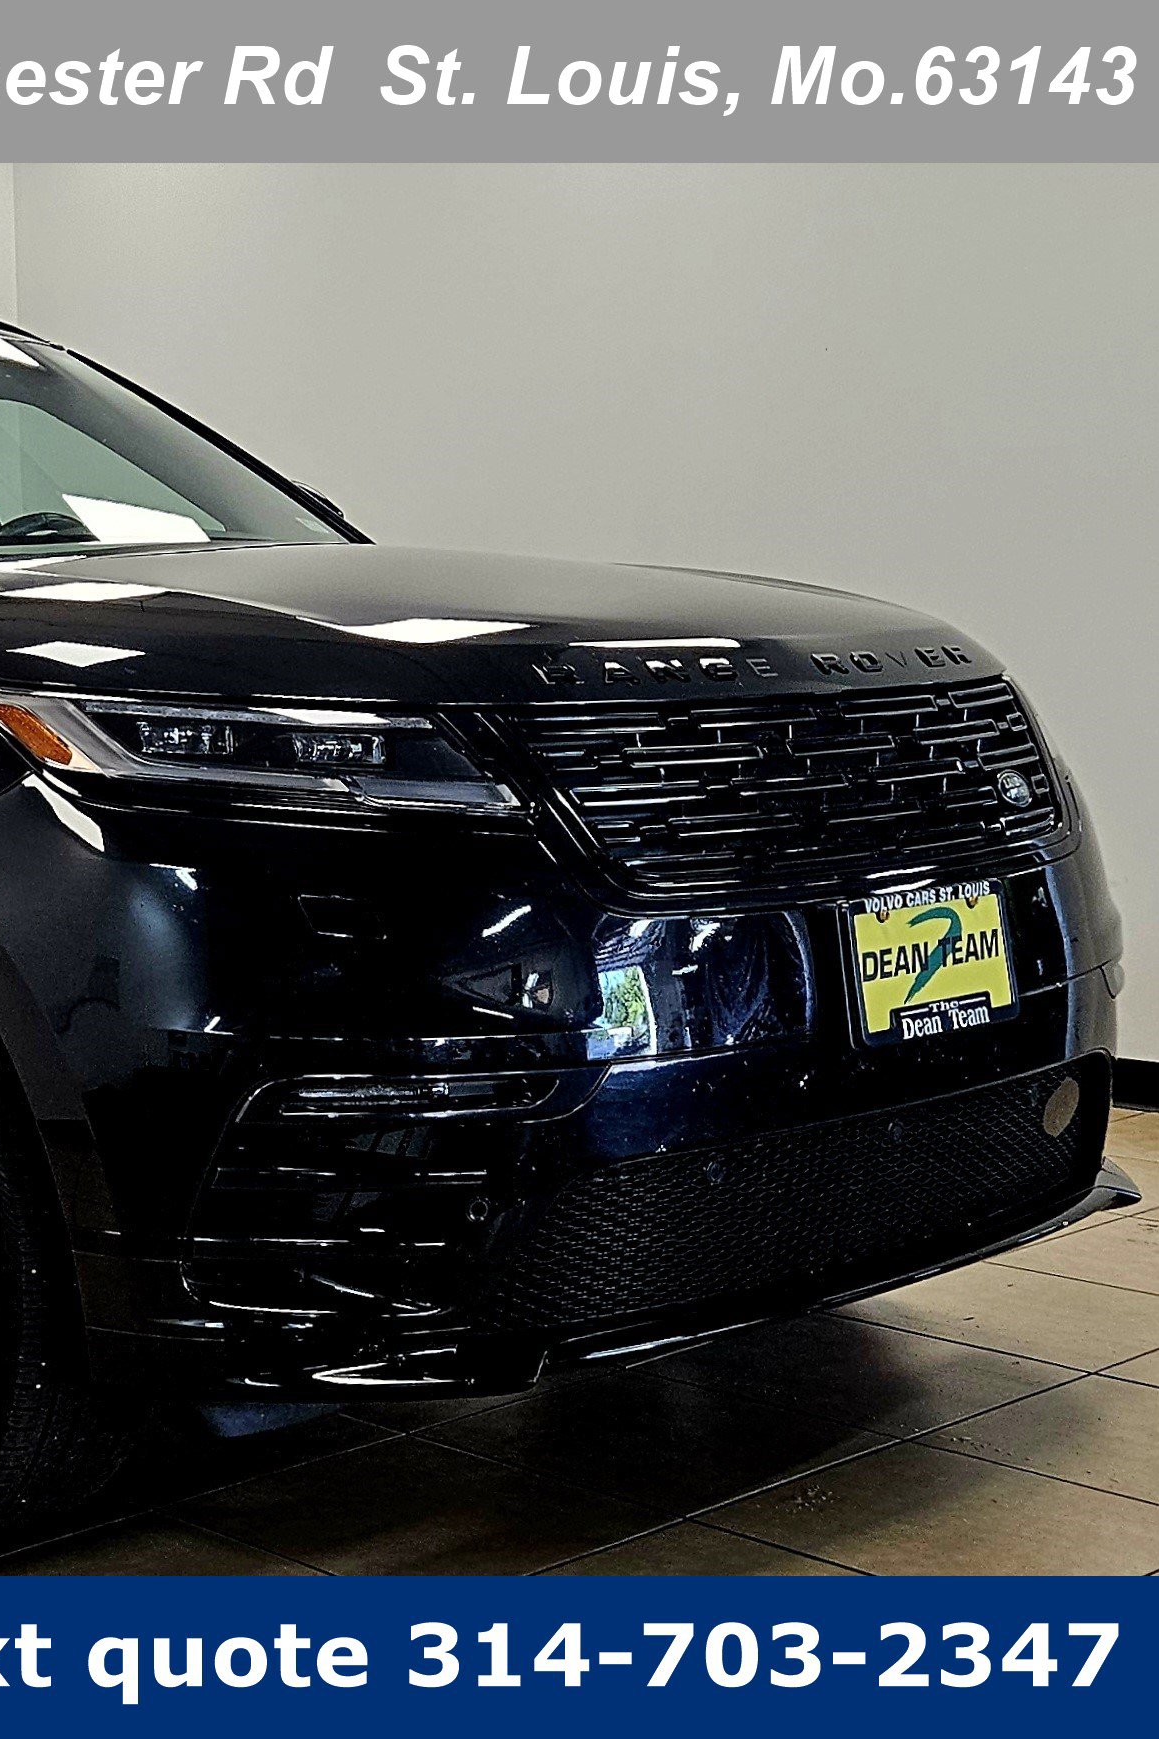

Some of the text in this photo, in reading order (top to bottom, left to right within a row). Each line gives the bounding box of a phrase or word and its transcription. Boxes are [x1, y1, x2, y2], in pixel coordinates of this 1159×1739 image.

[531, 644, 973, 685] RANGE ROVER
[864, 881, 991, 913] VOLVO CARS ST. LOUIS
[862, 929, 1000, 982] DEAN TEAM
[902, 1006, 990, 1040] Dean Team
[928, 1001, 960, 1013] The
